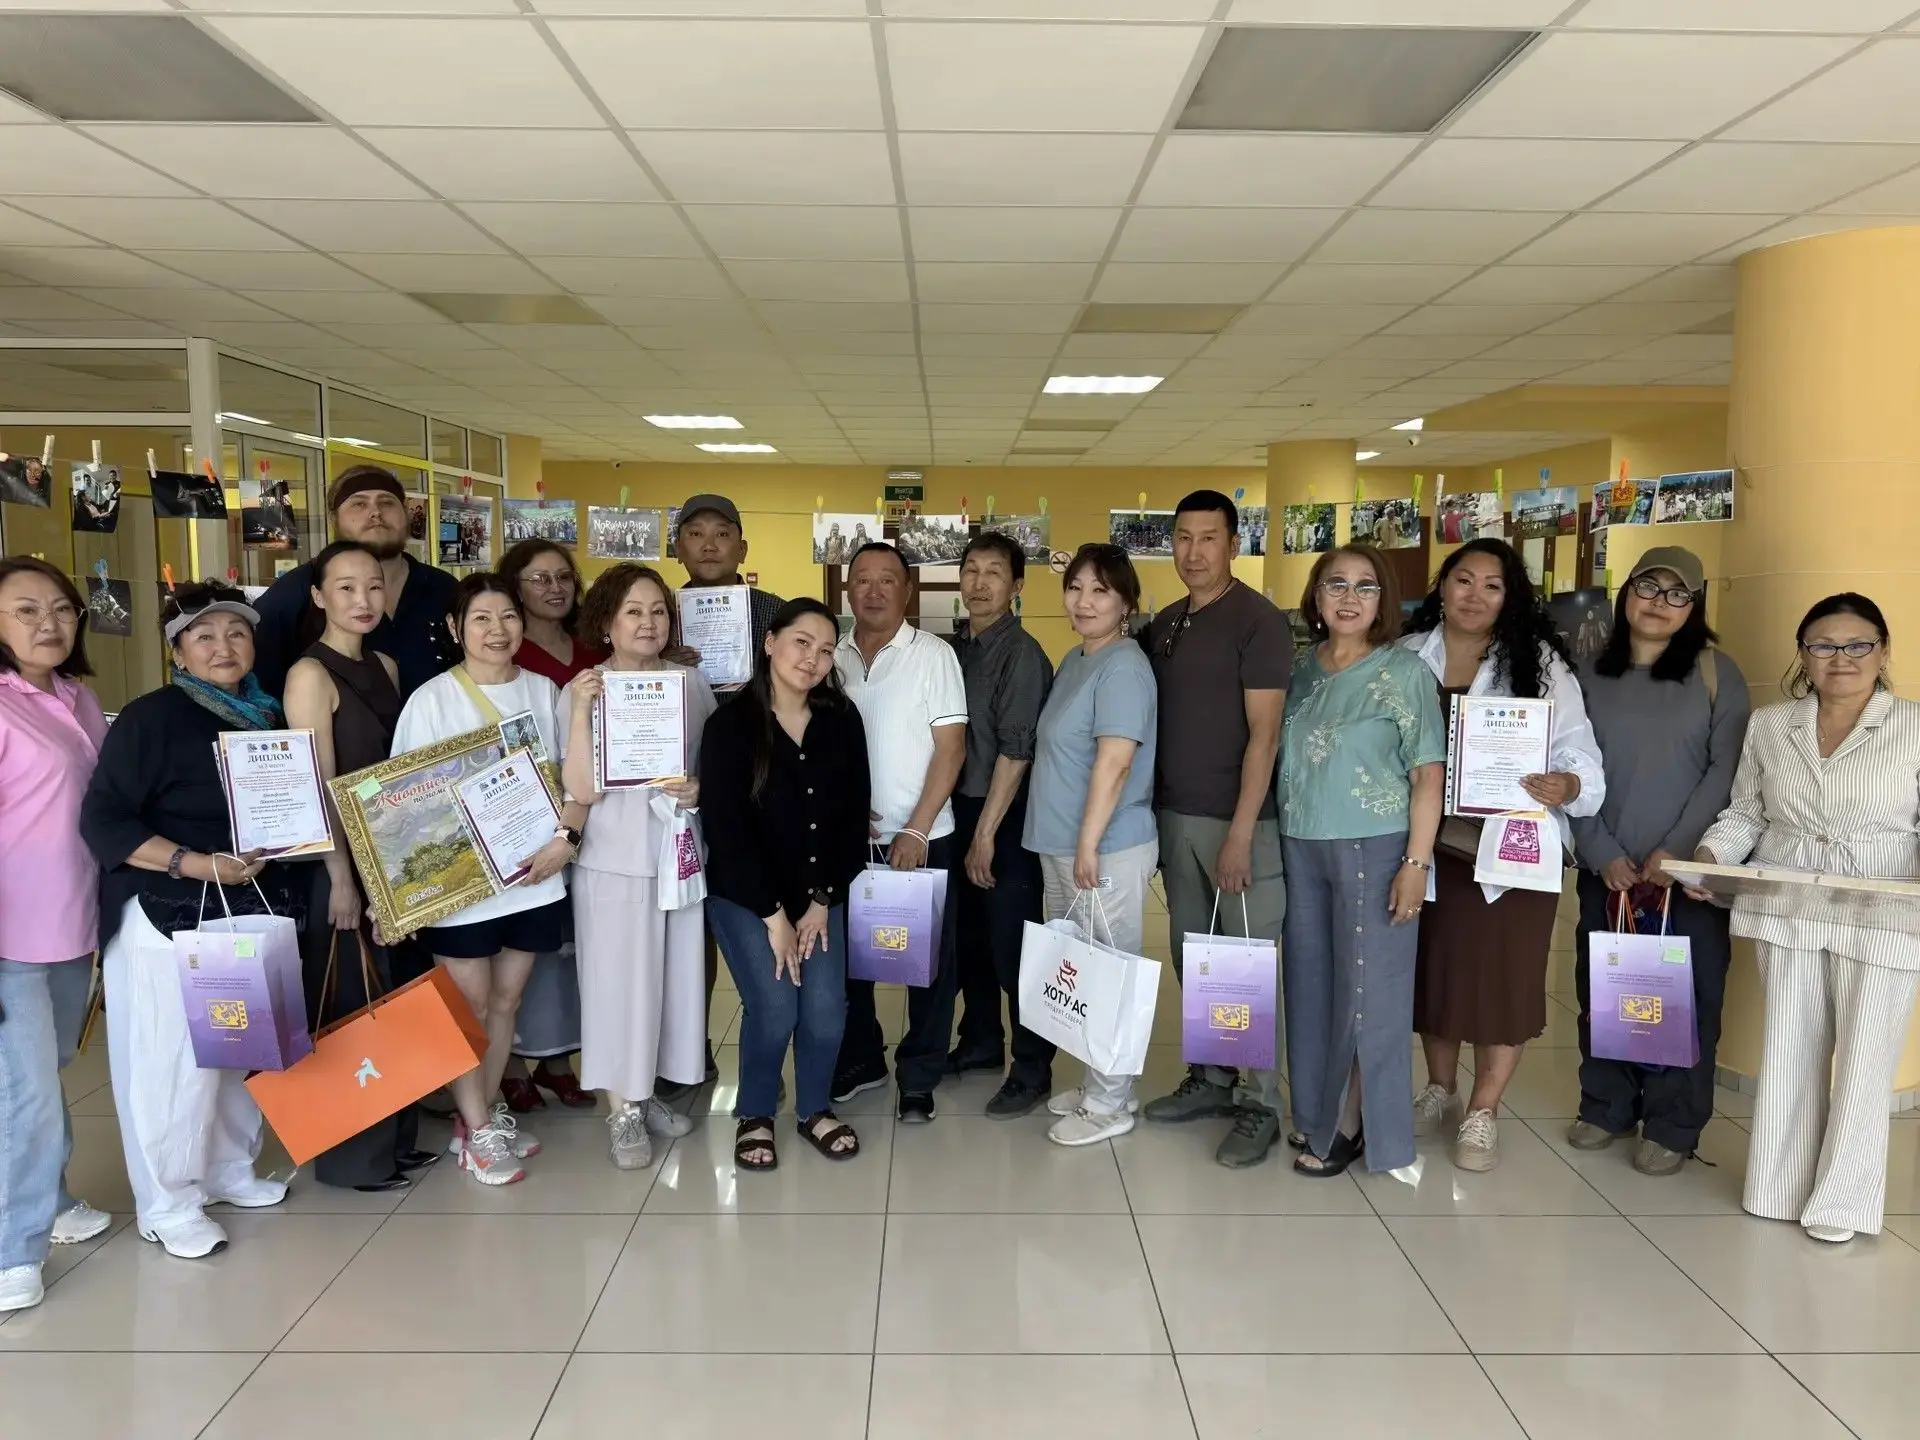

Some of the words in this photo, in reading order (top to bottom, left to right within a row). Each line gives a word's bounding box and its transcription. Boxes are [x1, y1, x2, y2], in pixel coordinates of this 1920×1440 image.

[593, 519, 628, 531] NORWAY
[629, 520, 651, 532] PARK
[696, 606, 732, 615] ДИПЛОМ
[624, 693, 665, 701] ДИПЛОМ
[1482, 720, 1528, 728] ДИПЛОМ
[247, 753, 293, 763] ДИПЛОМ
[371, 776, 449, 811] Живопись
[484, 776, 521, 802] ДИПЛОМ
